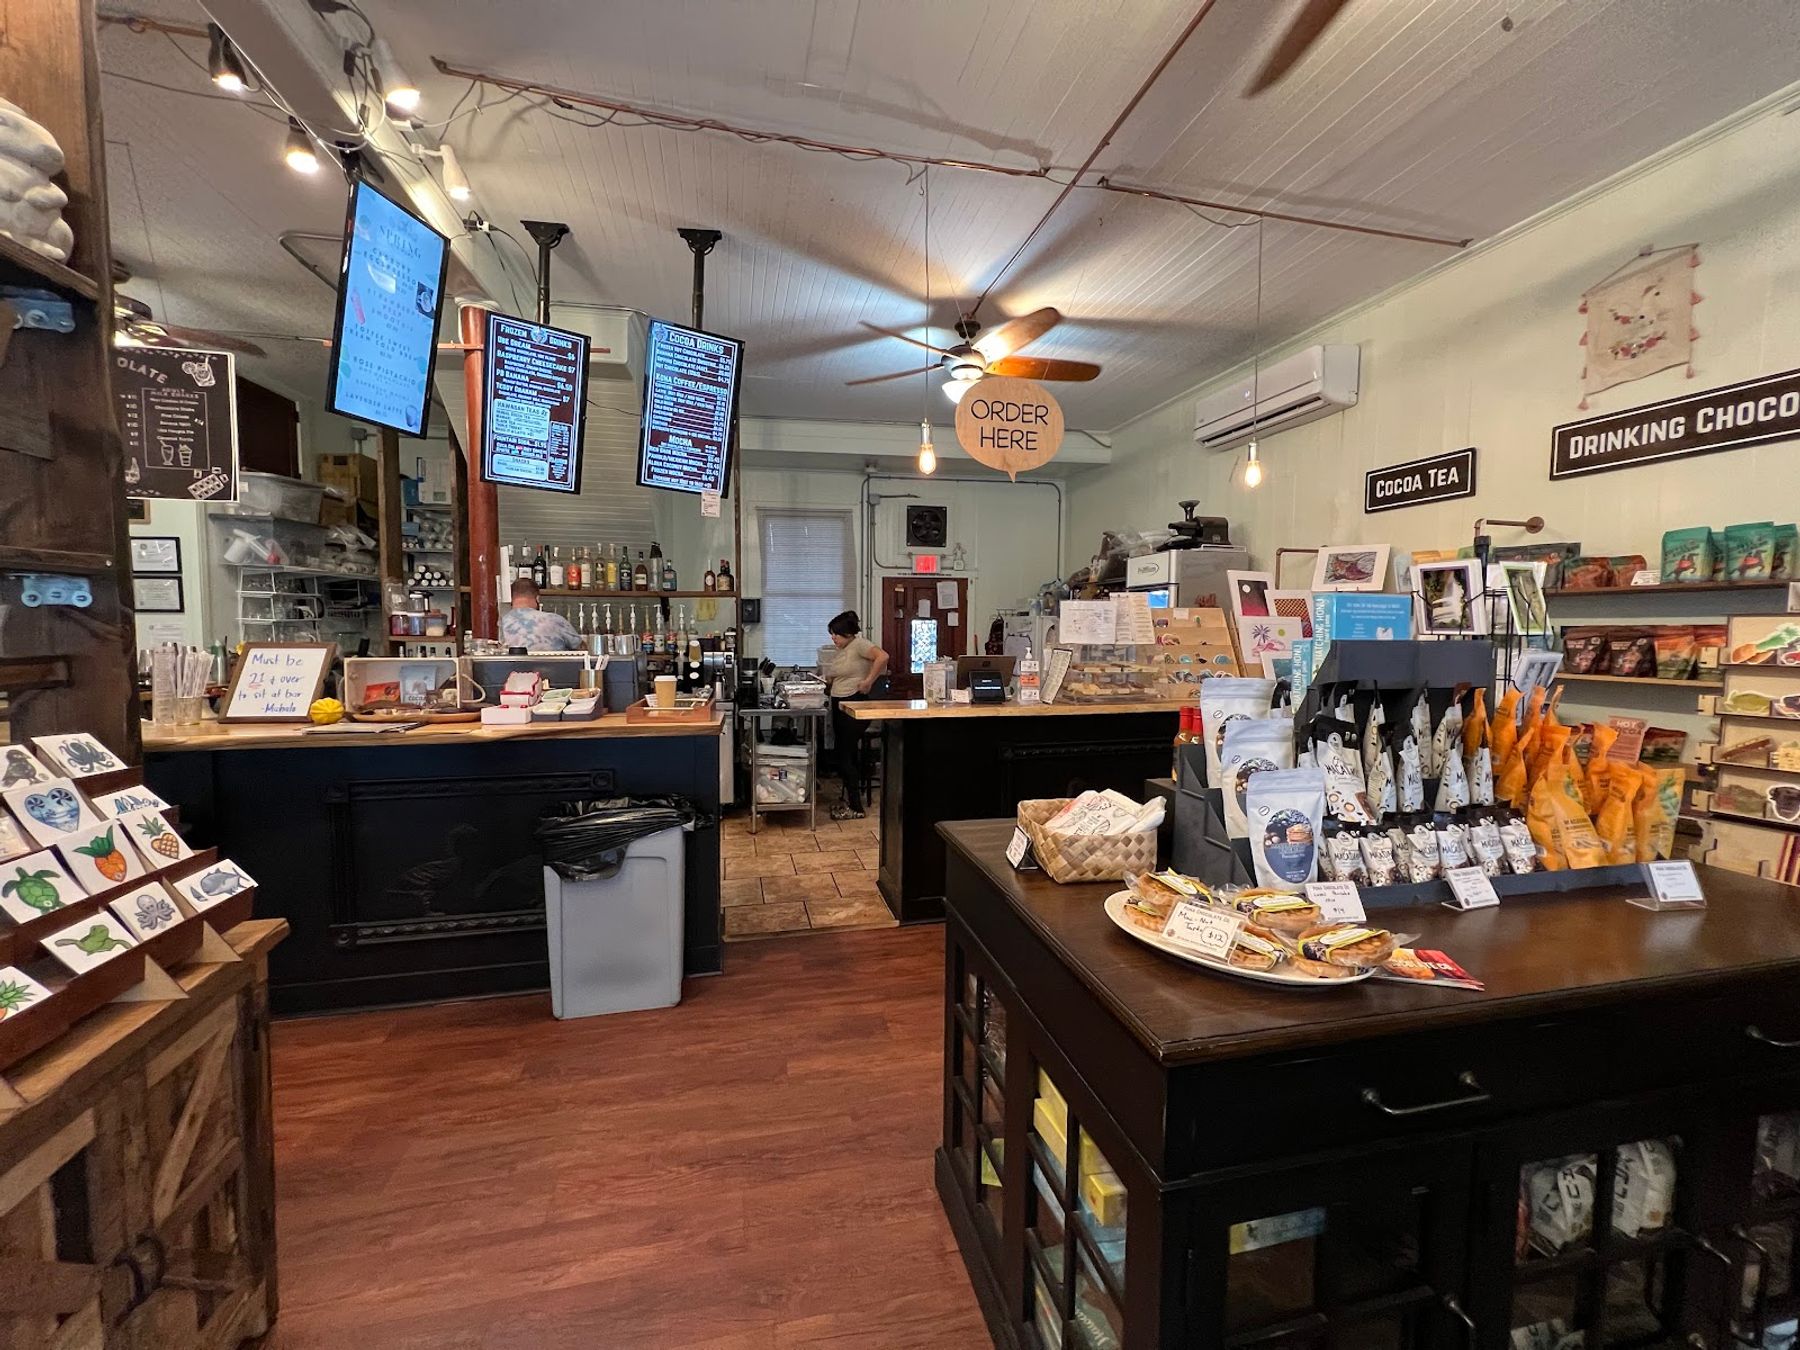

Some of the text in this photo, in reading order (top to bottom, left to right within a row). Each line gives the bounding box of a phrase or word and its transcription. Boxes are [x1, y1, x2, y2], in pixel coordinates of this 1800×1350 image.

[500, 324, 572, 348] FROZEN DRINKS
[669, 332, 724, 354] COCOA DRINKS
[496, 349, 530, 363] RASPBERRY
[531, 358, 566, 371] CHEESECAKE
[505, 371, 529, 381] BANANA
[971, 400, 1048, 426] ORDER
[1569, 392, 1800, 460] DRINKING CHOCO
[668, 435, 692, 446] MOCHA
[980, 426, 1038, 450] HERE
[1376, 466, 1459, 498] COCOA TEA
[252, 652, 304, 666] Must be
[250, 672, 264, 684] 21
[280, 675, 302, 684] over
[238, 688, 302, 700] to sit at bar
[1616, 720, 1636, 728] HOT
[1208, 932, 1224, 942] $12
